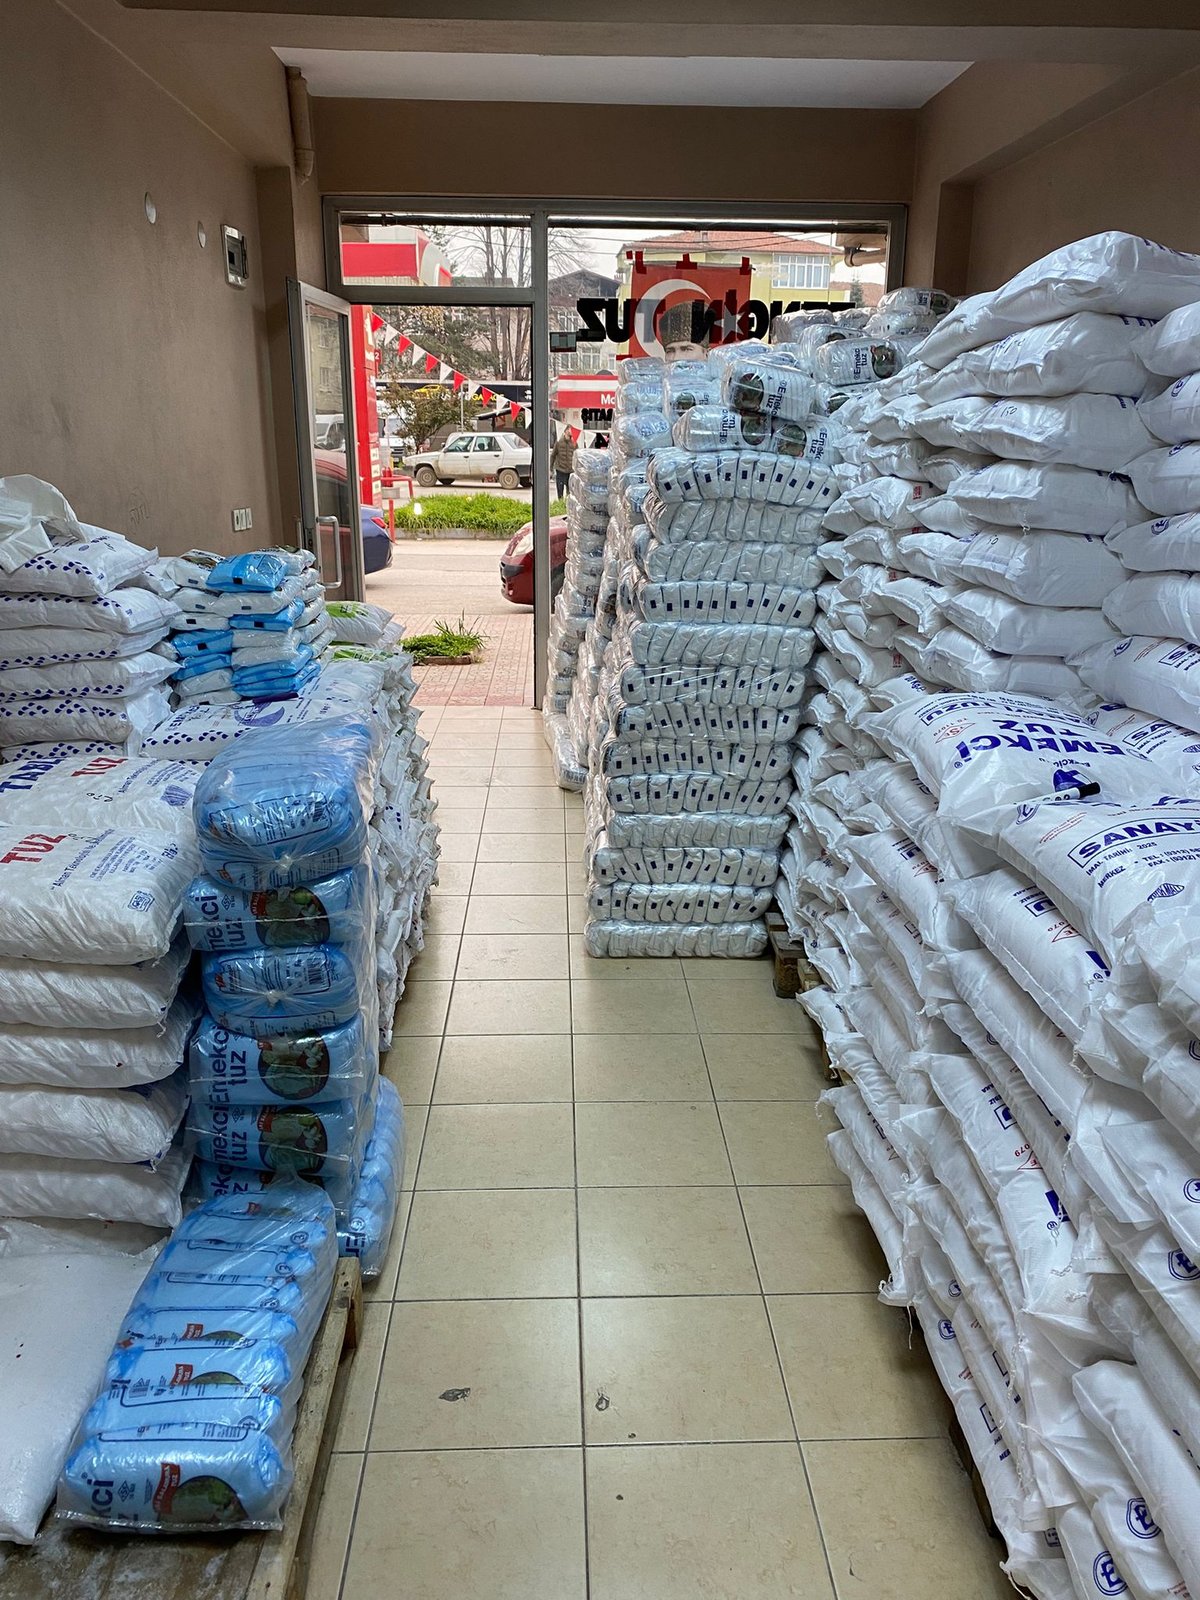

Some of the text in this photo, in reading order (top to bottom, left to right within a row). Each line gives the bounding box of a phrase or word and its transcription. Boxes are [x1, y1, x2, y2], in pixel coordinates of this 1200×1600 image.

[766, 394, 778, 409] tuz
[809, 438, 820, 455] tuz
[993, 719, 1088, 738] TUZ
[955, 733, 1126, 763] EMEKCİ
[0, 757, 66, 793] TABL
[71, 757, 129, 777] TUZ
[0, 833, 67, 863] TUZ
[1079, 820, 1200, 859] SANAY
[196, 894, 223, 951] mekci
[229, 1050, 247, 1087] tuz
[209, 1102, 229, 1163] mekci
[231, 1131, 248, 1162] tuz
[87, 1479, 114, 1519] kci
